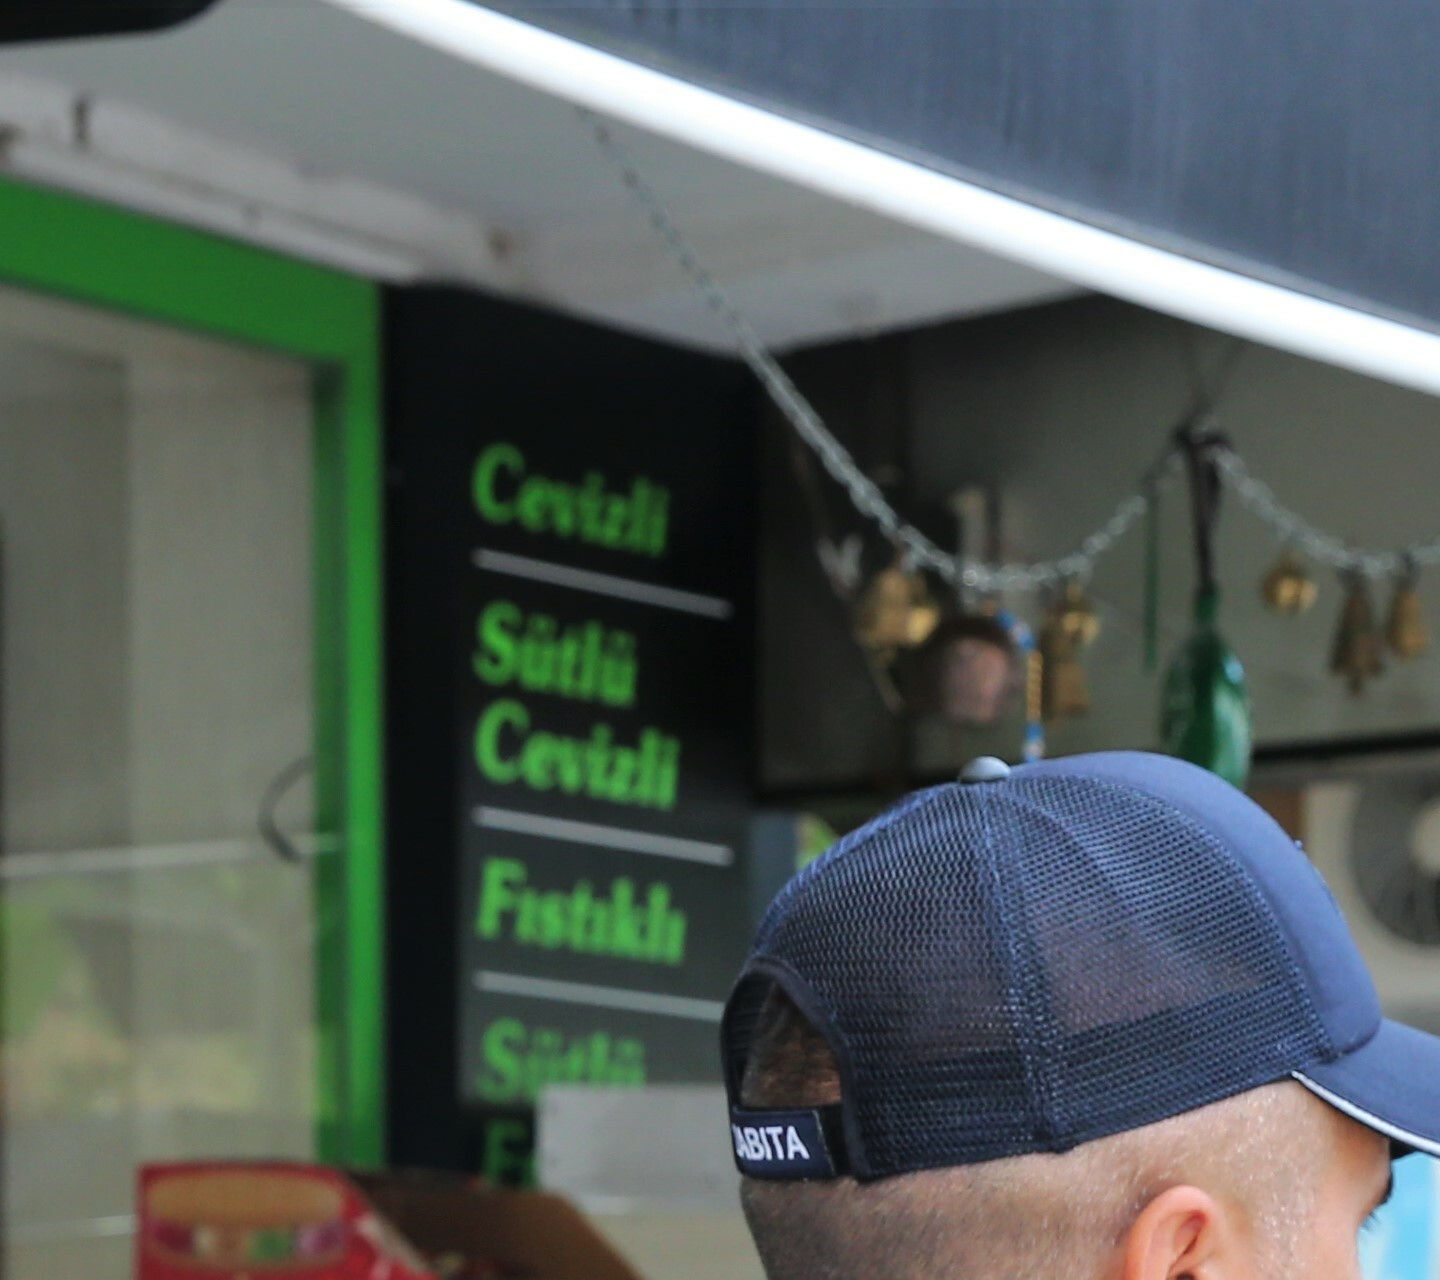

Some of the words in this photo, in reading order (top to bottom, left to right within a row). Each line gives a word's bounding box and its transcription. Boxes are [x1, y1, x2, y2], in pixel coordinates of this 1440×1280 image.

[472, 442, 671, 558] Cevizli
[473, 599, 638, 708] Sütlü
[474, 698, 681, 812] Cevizli
[732, 1123, 810, 1161] ABITA
